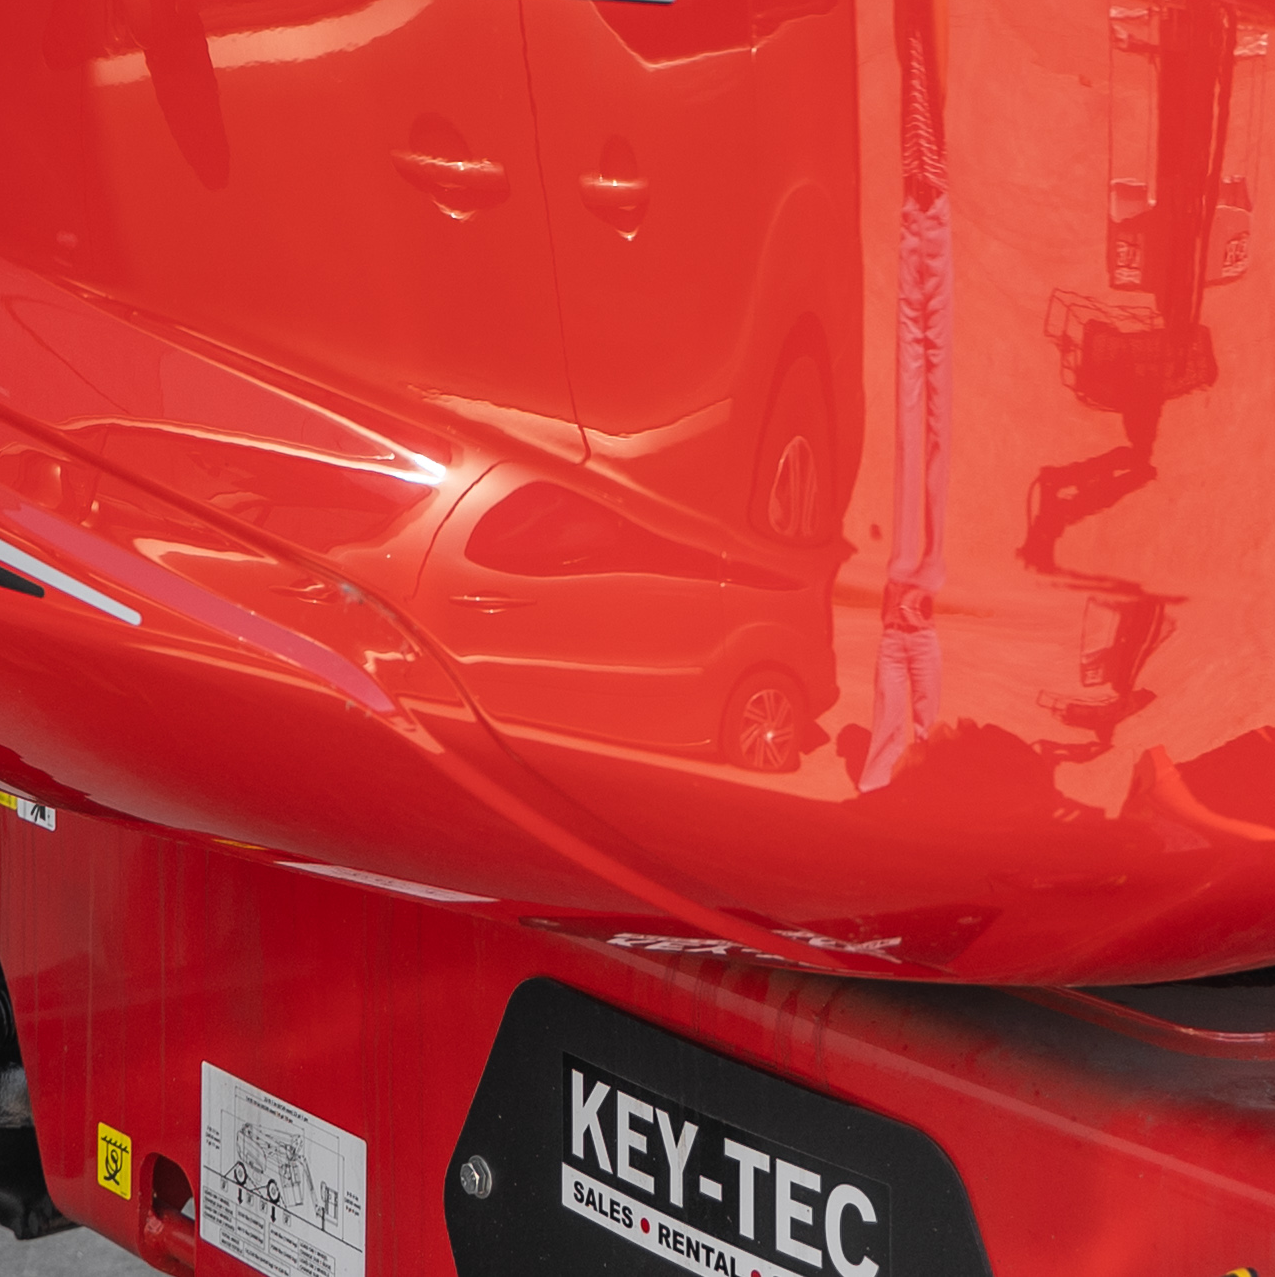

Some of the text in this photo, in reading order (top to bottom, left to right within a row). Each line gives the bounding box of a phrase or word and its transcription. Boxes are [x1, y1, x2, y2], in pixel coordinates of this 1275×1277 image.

[571, 1068, 880, 1277] KEY-TEC
[573, 1180, 739, 1277] SALES RENTAL
